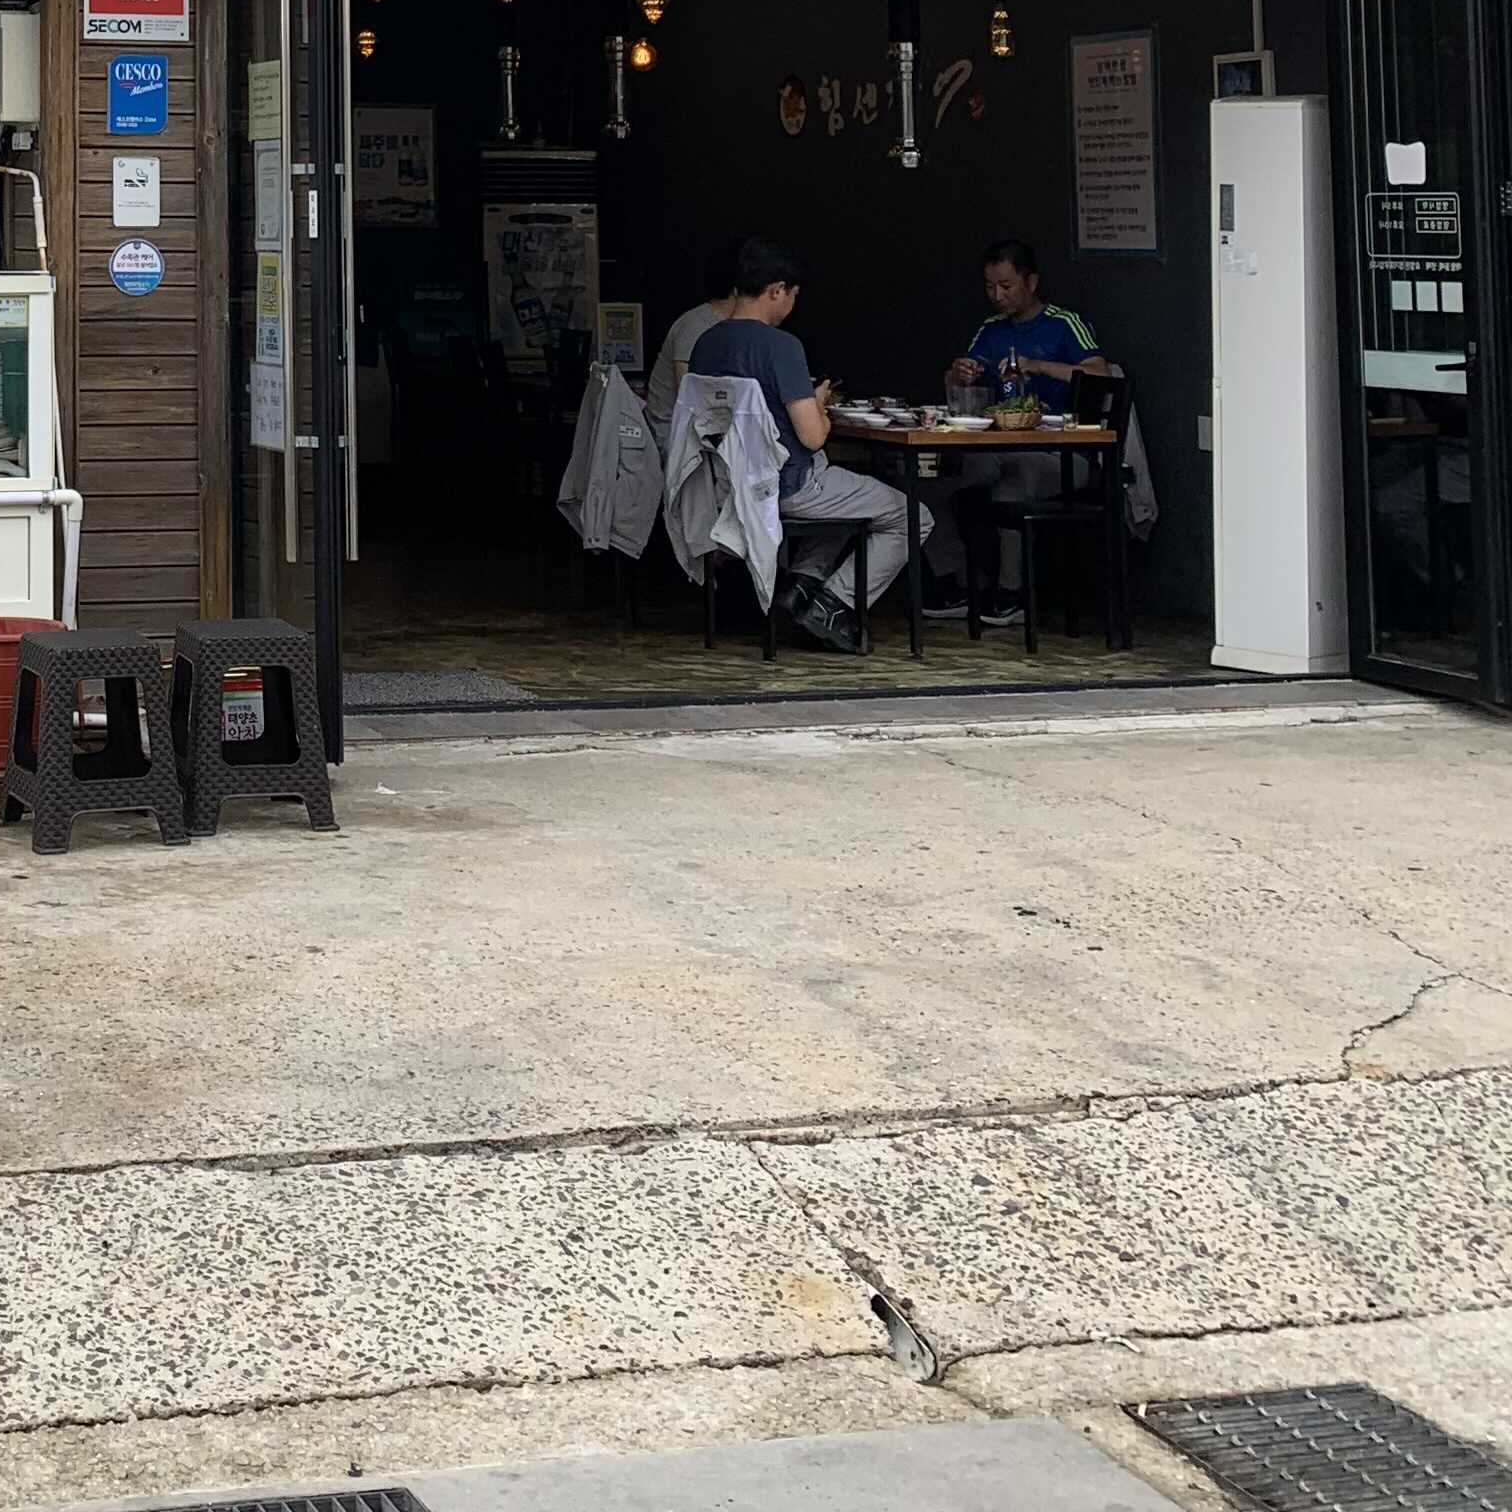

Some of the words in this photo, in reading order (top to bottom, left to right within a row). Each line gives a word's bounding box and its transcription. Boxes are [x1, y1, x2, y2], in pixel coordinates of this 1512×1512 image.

[87, 19, 142, 34] SECOM
[114, 63, 162, 81] CESCO
[228, 711, 259, 725] 태양초
